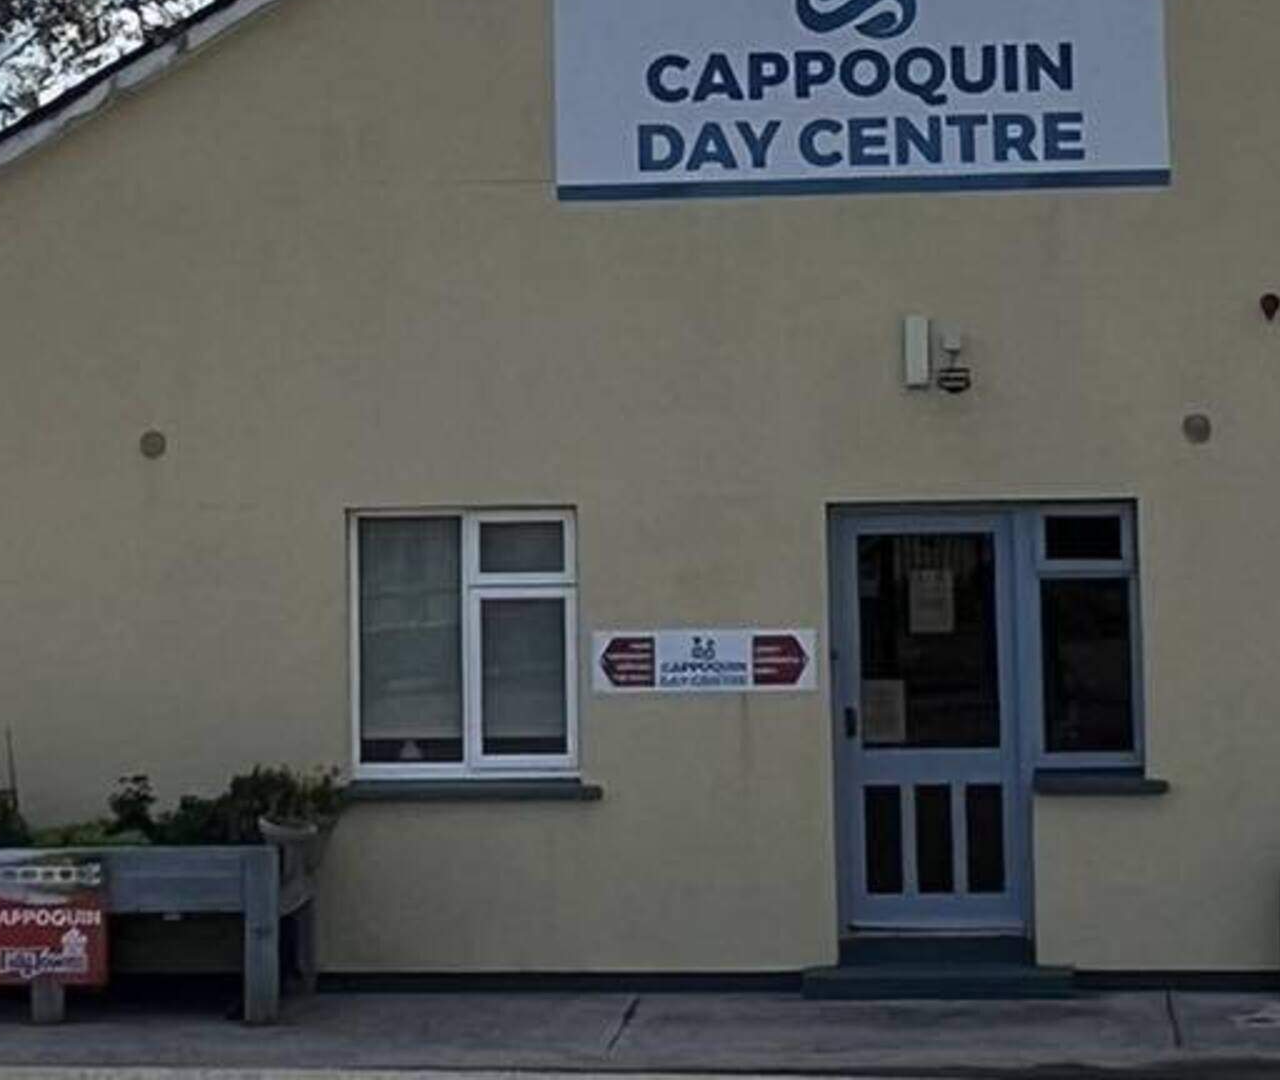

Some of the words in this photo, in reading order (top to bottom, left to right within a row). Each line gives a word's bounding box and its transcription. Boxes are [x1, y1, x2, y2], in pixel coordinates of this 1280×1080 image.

[645, 42, 1074, 105] CAPPOQUIN
[637, 120, 781, 173] DAY
[798, 112, 1086, 168] CENTRE
